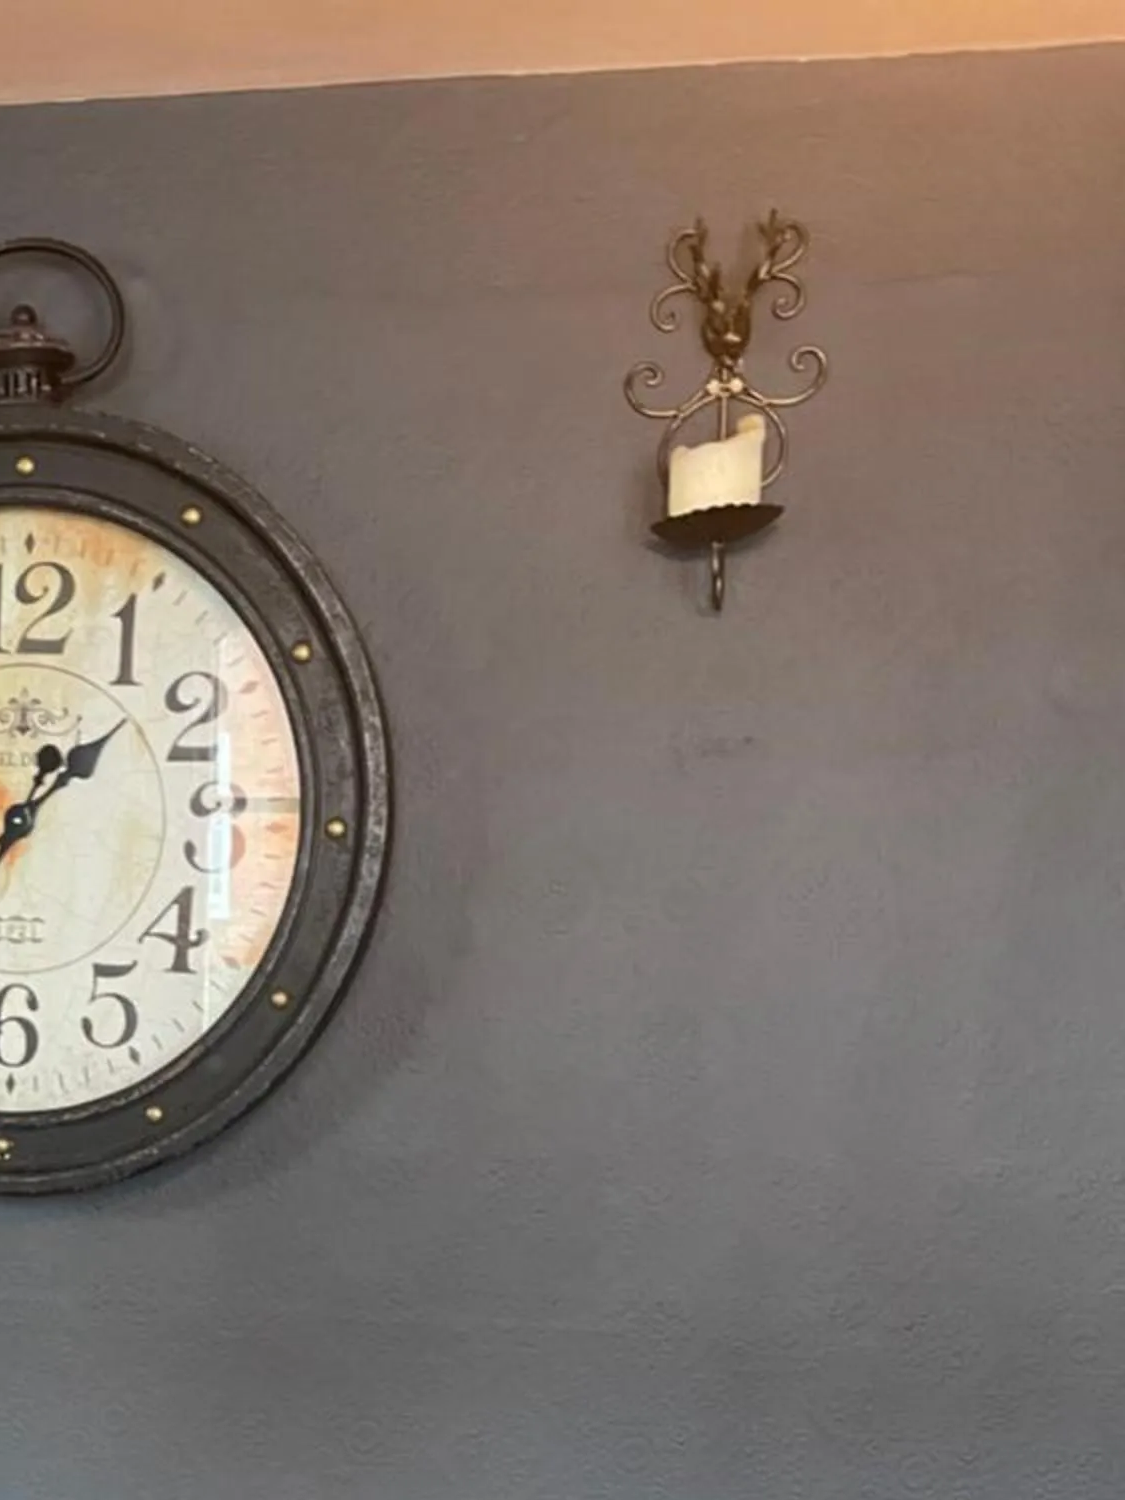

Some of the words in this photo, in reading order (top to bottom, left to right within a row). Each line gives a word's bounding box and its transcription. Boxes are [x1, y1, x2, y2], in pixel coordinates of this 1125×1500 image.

[108, 592, 144, 687] 1
[164, 671, 229, 763] 2
[183, 780, 248, 875] 3
[137, 885, 210, 975] 4
[81, 959, 139, 1049] 5
